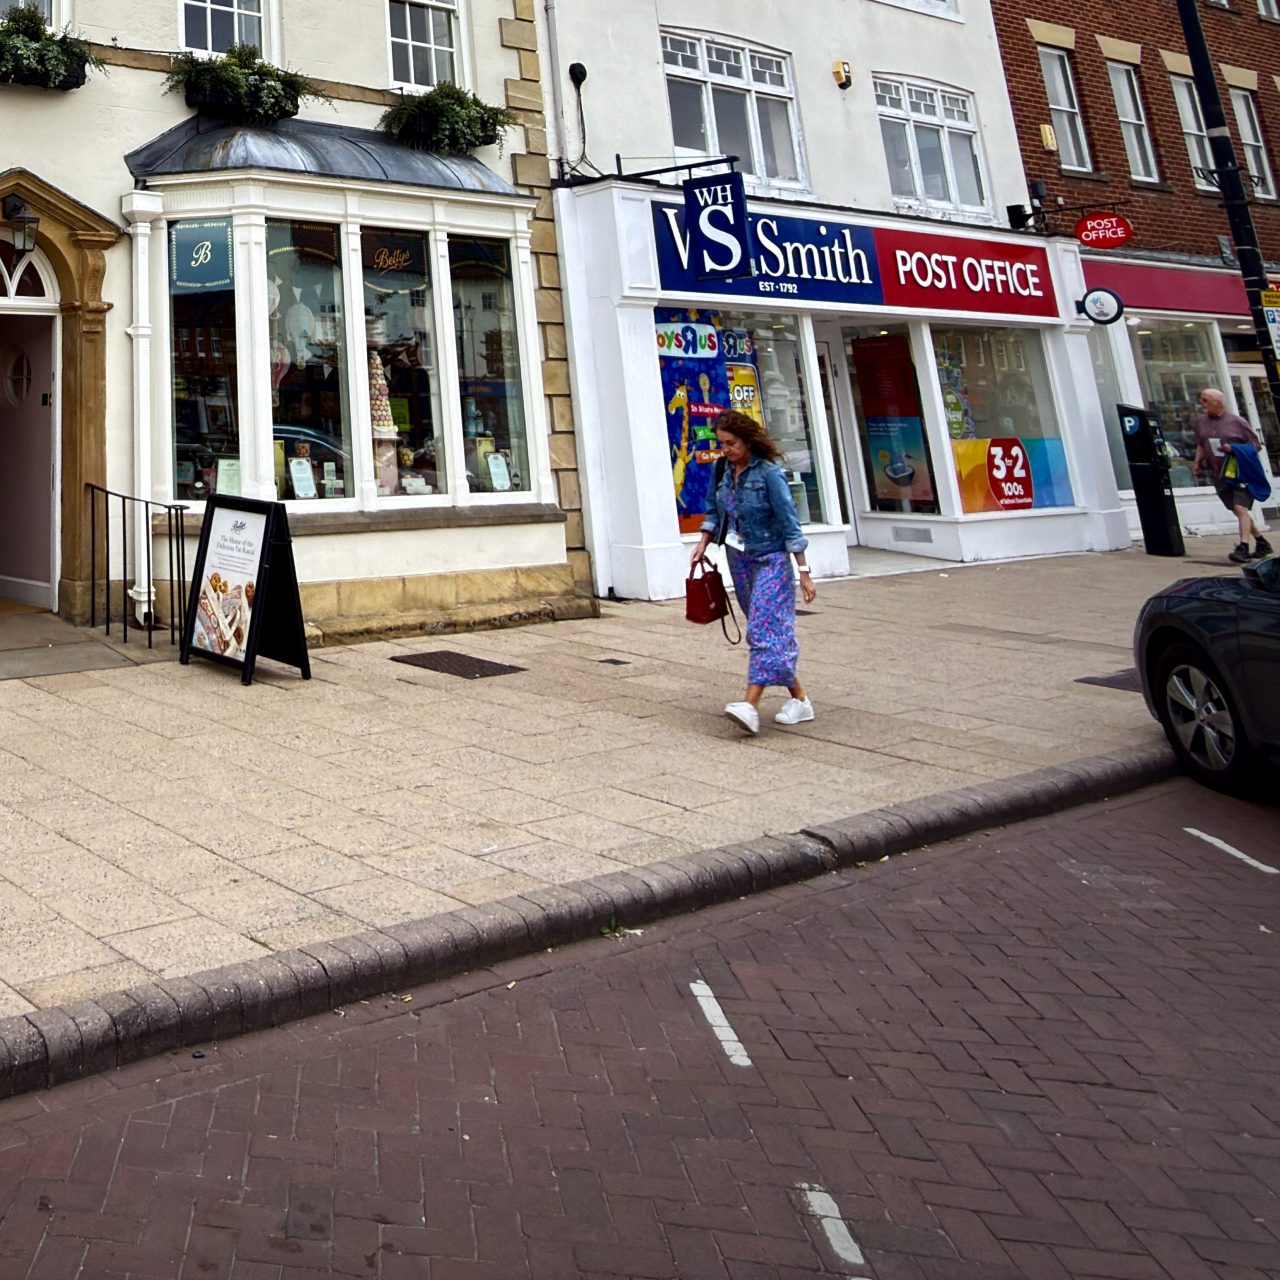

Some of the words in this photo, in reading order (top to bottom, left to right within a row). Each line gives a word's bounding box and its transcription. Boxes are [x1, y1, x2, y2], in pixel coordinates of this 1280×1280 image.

[694, 184, 734, 206] WH
[1081, 227, 1126, 241] OFFICE
[1086, 217, 1118, 230] POST
[699, 204, 742, 272] S
[374, 248, 412, 271] Bettys
[896, 250, 957, 290] POST
[962, 257, 1043, 297] OFFICE
[734, 385, 755, 401] OFF
[991, 446, 1007, 479] 3
[1011, 446, 1026, 477] 2
[1001, 482, 1024, 496] 100s
